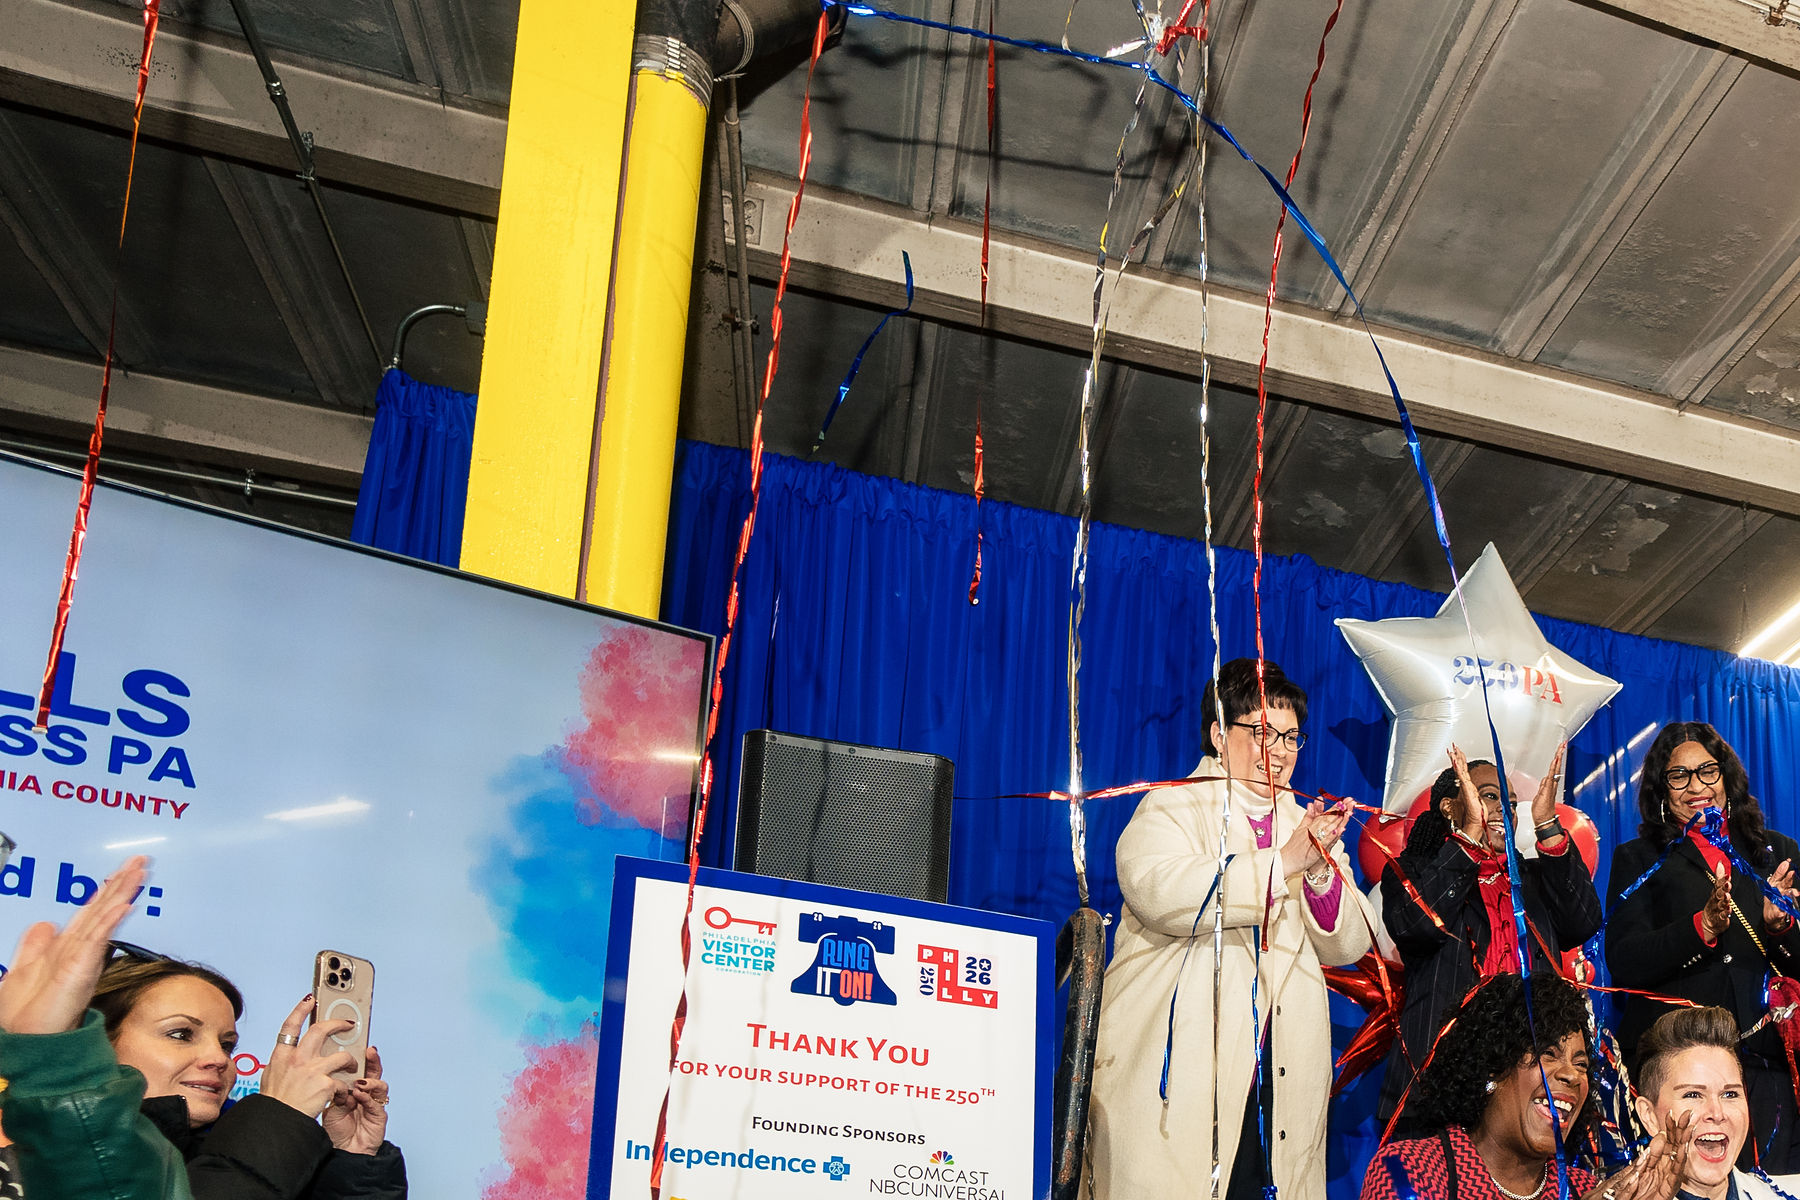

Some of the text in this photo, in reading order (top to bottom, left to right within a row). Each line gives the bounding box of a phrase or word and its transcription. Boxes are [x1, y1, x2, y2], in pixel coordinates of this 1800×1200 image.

[107, 735, 196, 789] PA
[52, 780, 190, 820] COUNTY
[56, 862, 163, 918] b:
[702, 939, 776, 959] VISITOR
[703, 931, 776, 946] PHILADELPHIA
[822, 938, 870, 971] RING
[701, 952, 775, 972] CENTER
[965, 970, 991, 985] 26
[816, 966, 874, 1001] IT ON!
[747, 1023, 929, 1066] THANK YOU
[715, 1064, 772, 1082] YOUR
[777, 1071, 870, 1092] SUPPORT
[875, 1081, 900, 1095] OF
[904, 1084, 941, 1100] THE
[752, 1116, 926, 1145] FOUNDING SPONSORS
[893, 1164, 989, 1186] COMCAST
